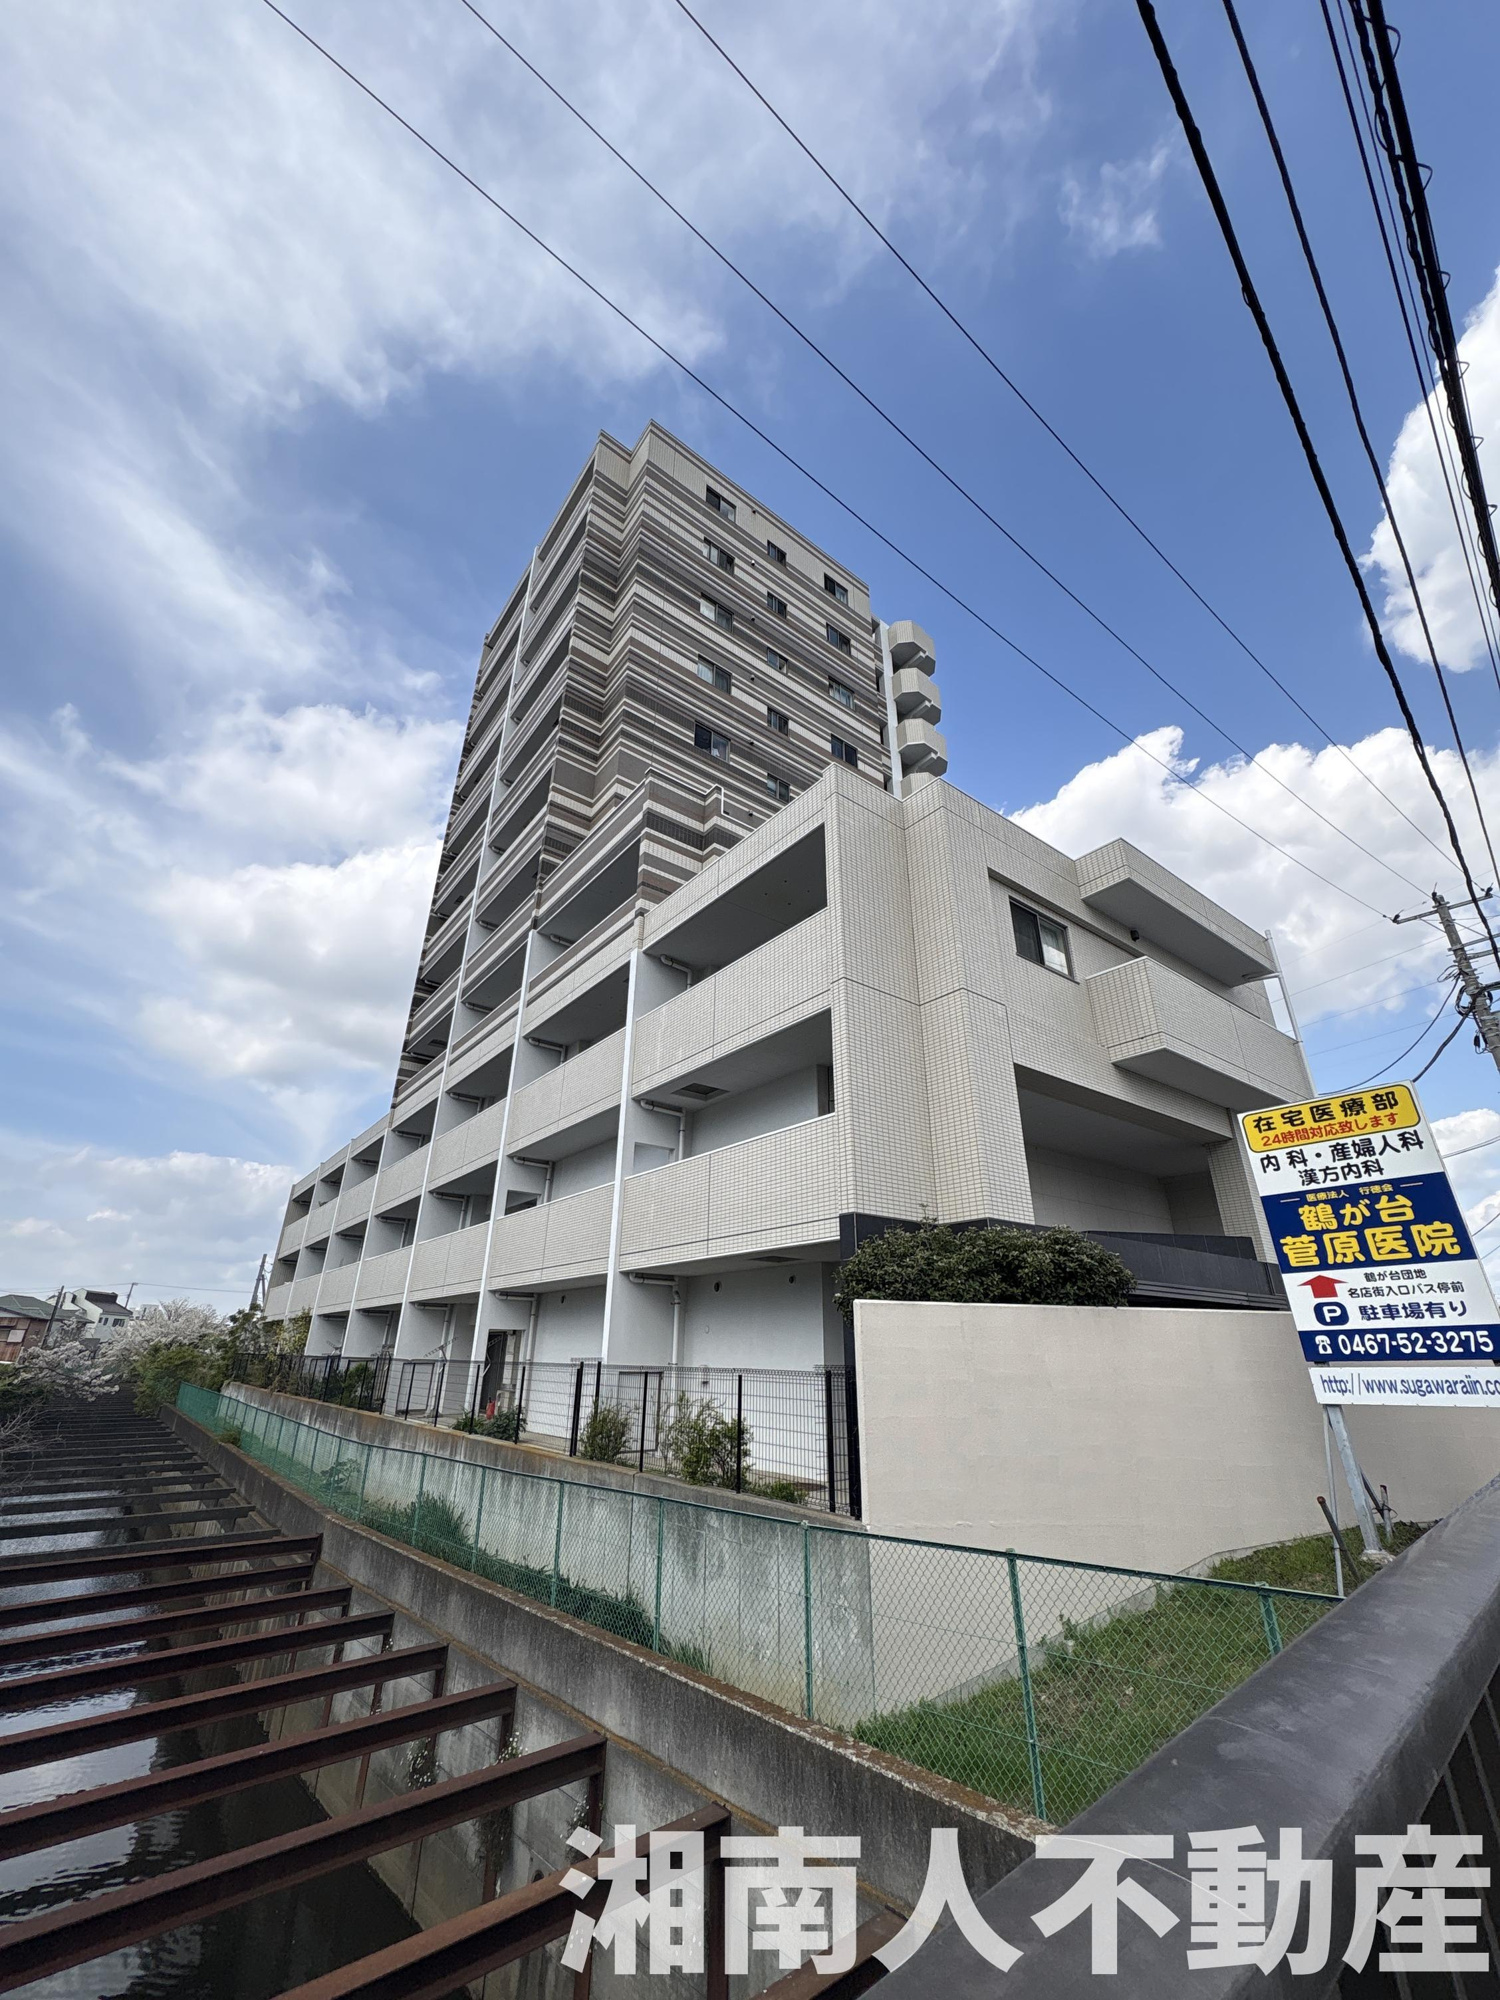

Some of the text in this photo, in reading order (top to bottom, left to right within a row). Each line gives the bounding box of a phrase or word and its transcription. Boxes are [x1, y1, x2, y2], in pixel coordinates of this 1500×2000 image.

[1253, 1090, 1399, 1134] 在宅医療部
[1261, 1112, 1399, 1147] 24時間対応致します
[1298, 1158, 1384, 1187] 漢方内科
[1306, 1189, 1349, 1202] 医療法人
[1298, 1194, 1415, 1232] 鶴が台
[1280, 1221, 1461, 1268] 菅原医院
[1364, 1268, 1427, 1283] 鶴が台団地
[1347, 1281, 1465, 1299] 名店街入口バス停前
[1358, 1300, 1467, 1322] 駐車場有り
[1338, 1330, 1494, 1355] 0467-52-3275
